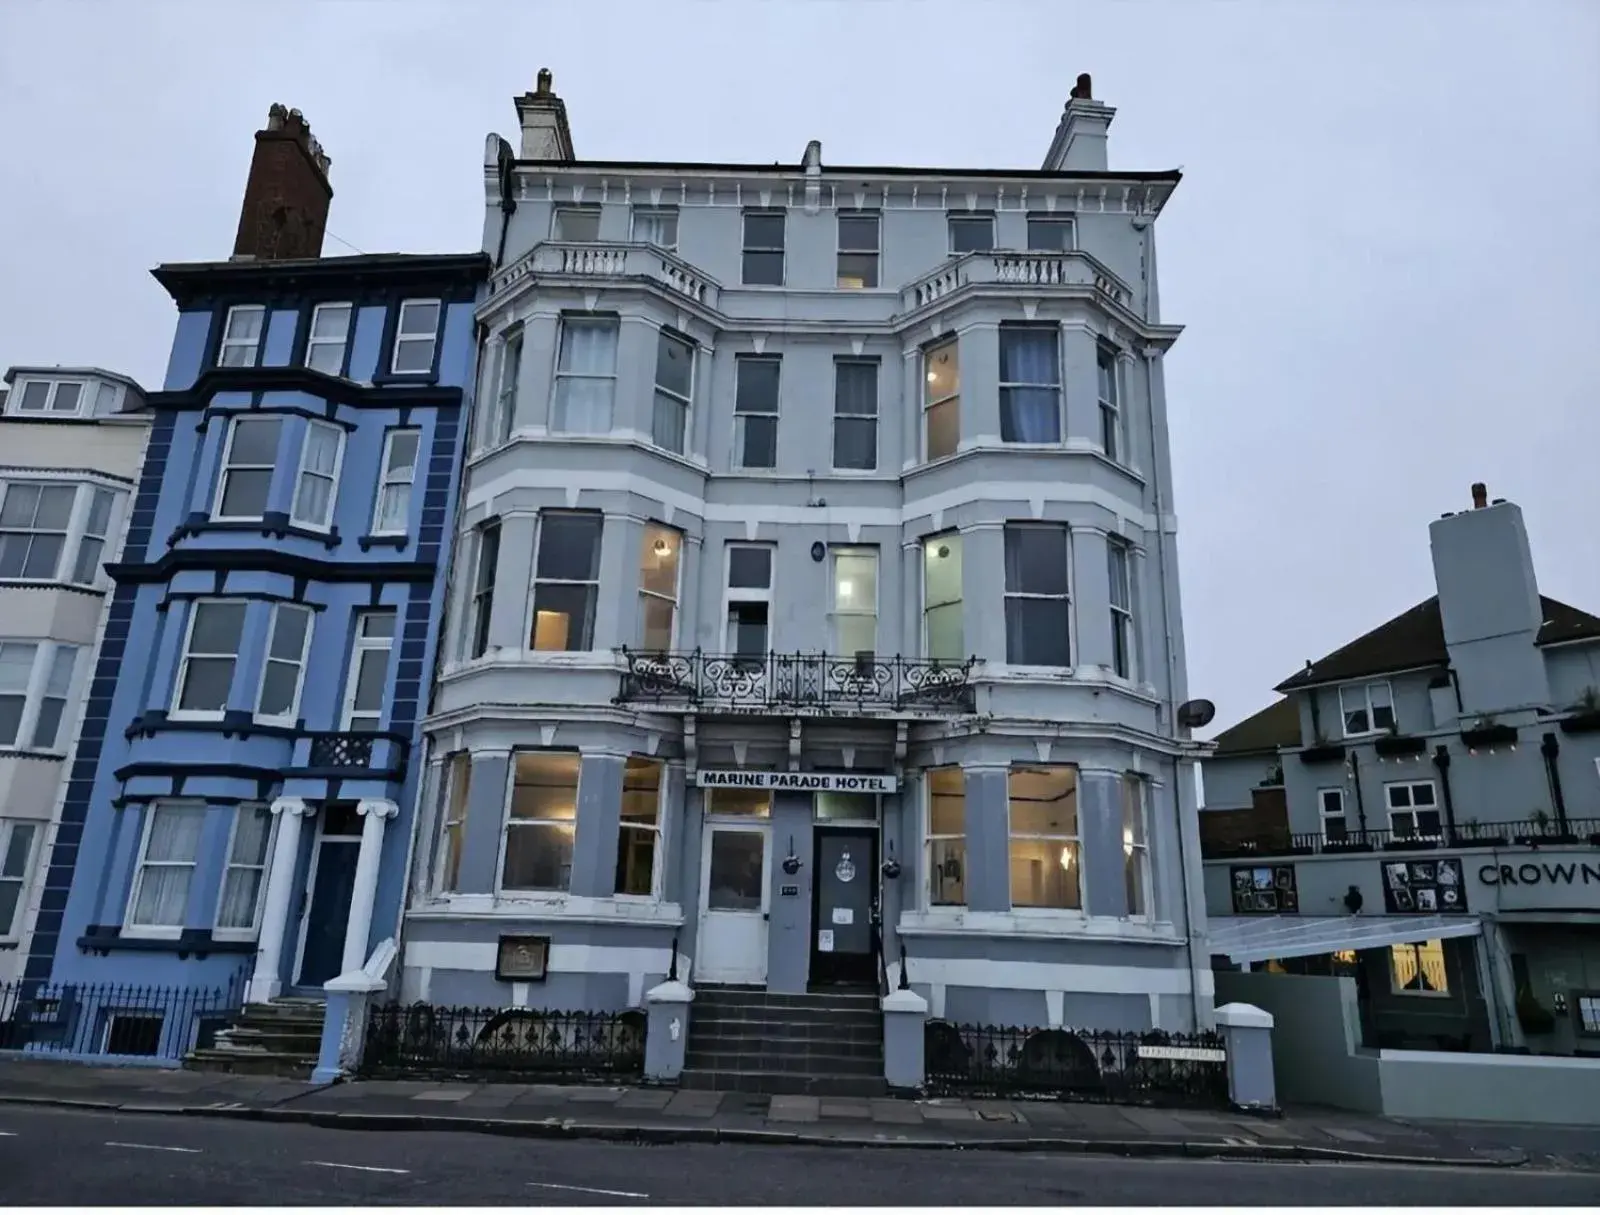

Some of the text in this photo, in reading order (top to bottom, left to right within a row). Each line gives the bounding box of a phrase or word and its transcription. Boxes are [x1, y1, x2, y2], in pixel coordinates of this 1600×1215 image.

[703, 772, 887, 790] MARINE PARADE HOTEL
[1479, 863, 1600, 885] CROWN
